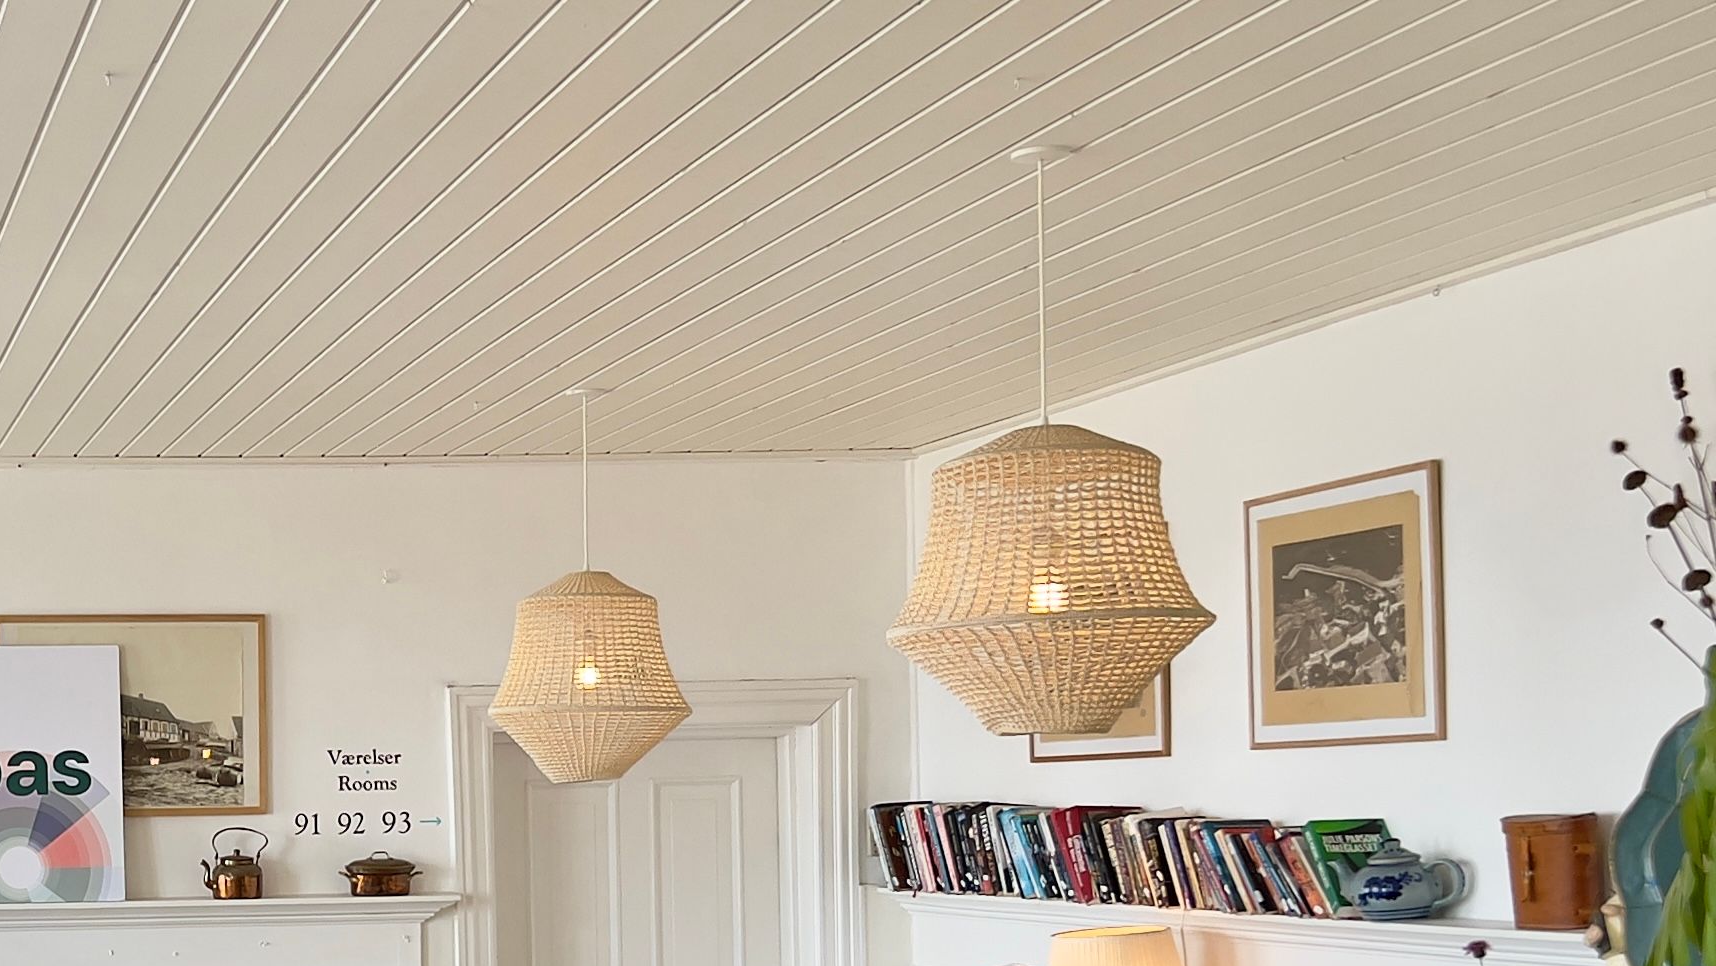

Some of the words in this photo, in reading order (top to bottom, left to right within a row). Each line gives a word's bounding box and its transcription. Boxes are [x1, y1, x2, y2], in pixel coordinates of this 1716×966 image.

[326, 748, 402, 766] Værelser
[337, 775, 398, 792] Rooms
[294, 812, 322, 836] 91
[337, 811, 366, 836] 92
[381, 810, 412, 834] 93
